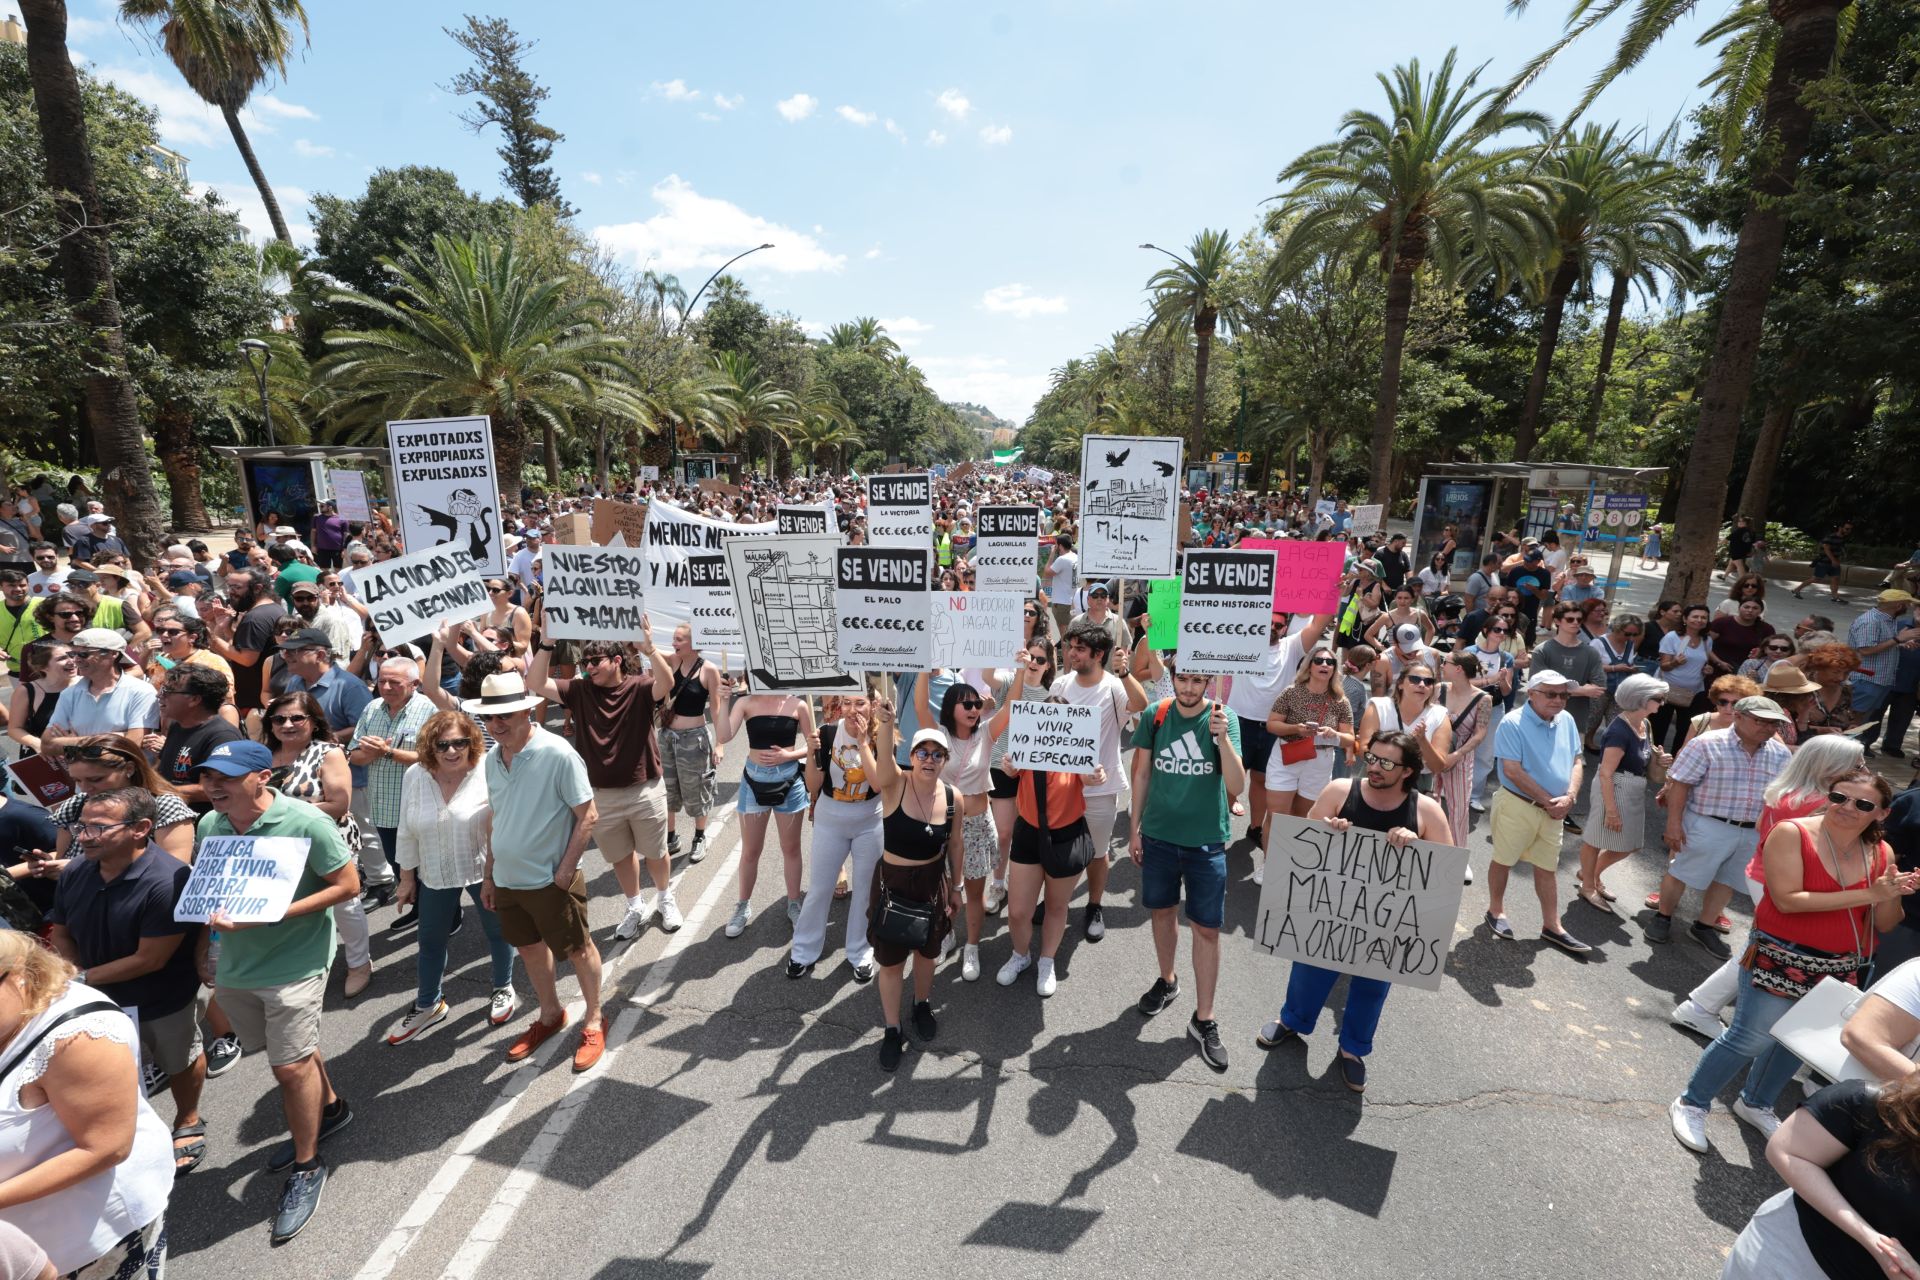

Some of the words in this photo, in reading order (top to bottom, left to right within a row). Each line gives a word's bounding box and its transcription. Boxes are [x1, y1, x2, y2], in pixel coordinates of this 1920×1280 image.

[397, 430, 483, 448] EXPLOTADXS
[399, 447, 485, 465] EXPROPIADXS
[1216, 452, 1225, 462] P
[402, 465, 488, 482] EXPULSADXS
[872, 484, 887, 500] SE
[888, 482, 928, 500] VENDE
[781, 515, 792, 532] SE
[792, 516, 824, 533] VENDE
[981, 514, 996, 532] SE
[998, 514, 1036, 532] VENDE
[1592, 513, 1600, 523] 3
[1611, 513, 1618, 523] 8
[1627, 513, 1638, 523] 11
[649, 521, 701, 547] MENOS
[1096, 520, 1149, 560] Málaga
[1586, 529, 1600, 540] N1
[550, 552, 641, 577] NUESTRO
[692, 564, 706, 581] SE
[841, 557, 863, 582] SE
[867, 557, 923, 584] VENDE
[1301, 567, 1329, 580] LOS
[364, 574, 396, 604] LA
[389, 555, 458, 594] CIUDAD
[450, 550, 478, 574] ES
[649, 562, 659, 586] Y
[1188, 562, 1210, 586] SE
[1213, 562, 1270, 588] VENDE
[546, 576, 644, 600] ALQUILER
[373, 607, 404, 632] SU
[406, 580, 488, 620] VECINDAD
[864, 595, 876, 603] EL
[878, 597, 902, 605] PALO
[949, 596, 968, 612] NO
[1182, 599, 1219, 608] CENTRO
[544, 606, 570, 624] TU
[573, 604, 643, 631] PAGUITA
[961, 615, 998, 632] PAGAR
[1000, 615, 1015, 632] EL
[962, 638, 1015, 658] ALQUILER
[1012, 701, 1059, 716] MÁLAGA
[1066, 706, 1092, 718] PARA
[1036, 720, 1073, 735] VIVIR
[1011, 733, 1030, 745] NO
[1033, 735, 1096, 751] HOSPEDAR
[1011, 750, 1025, 763] NI
[1029, 751, 1095, 768] ESPECULAR
[1154, 757, 1214, 775] adidas
[1291, 826, 1334, 873] SI
[1336, 830, 1433, 891] VENDEN
[193, 859, 227, 877] PARA
[230, 859, 277, 880] VIVIR,
[185, 878, 206, 896] NO
[205, 878, 249, 896] PARA
[1286, 871, 1420, 937] MALAGA
[1260, 909, 1300, 956] LA
[1305, 919, 1441, 976] OKUPAMOS
